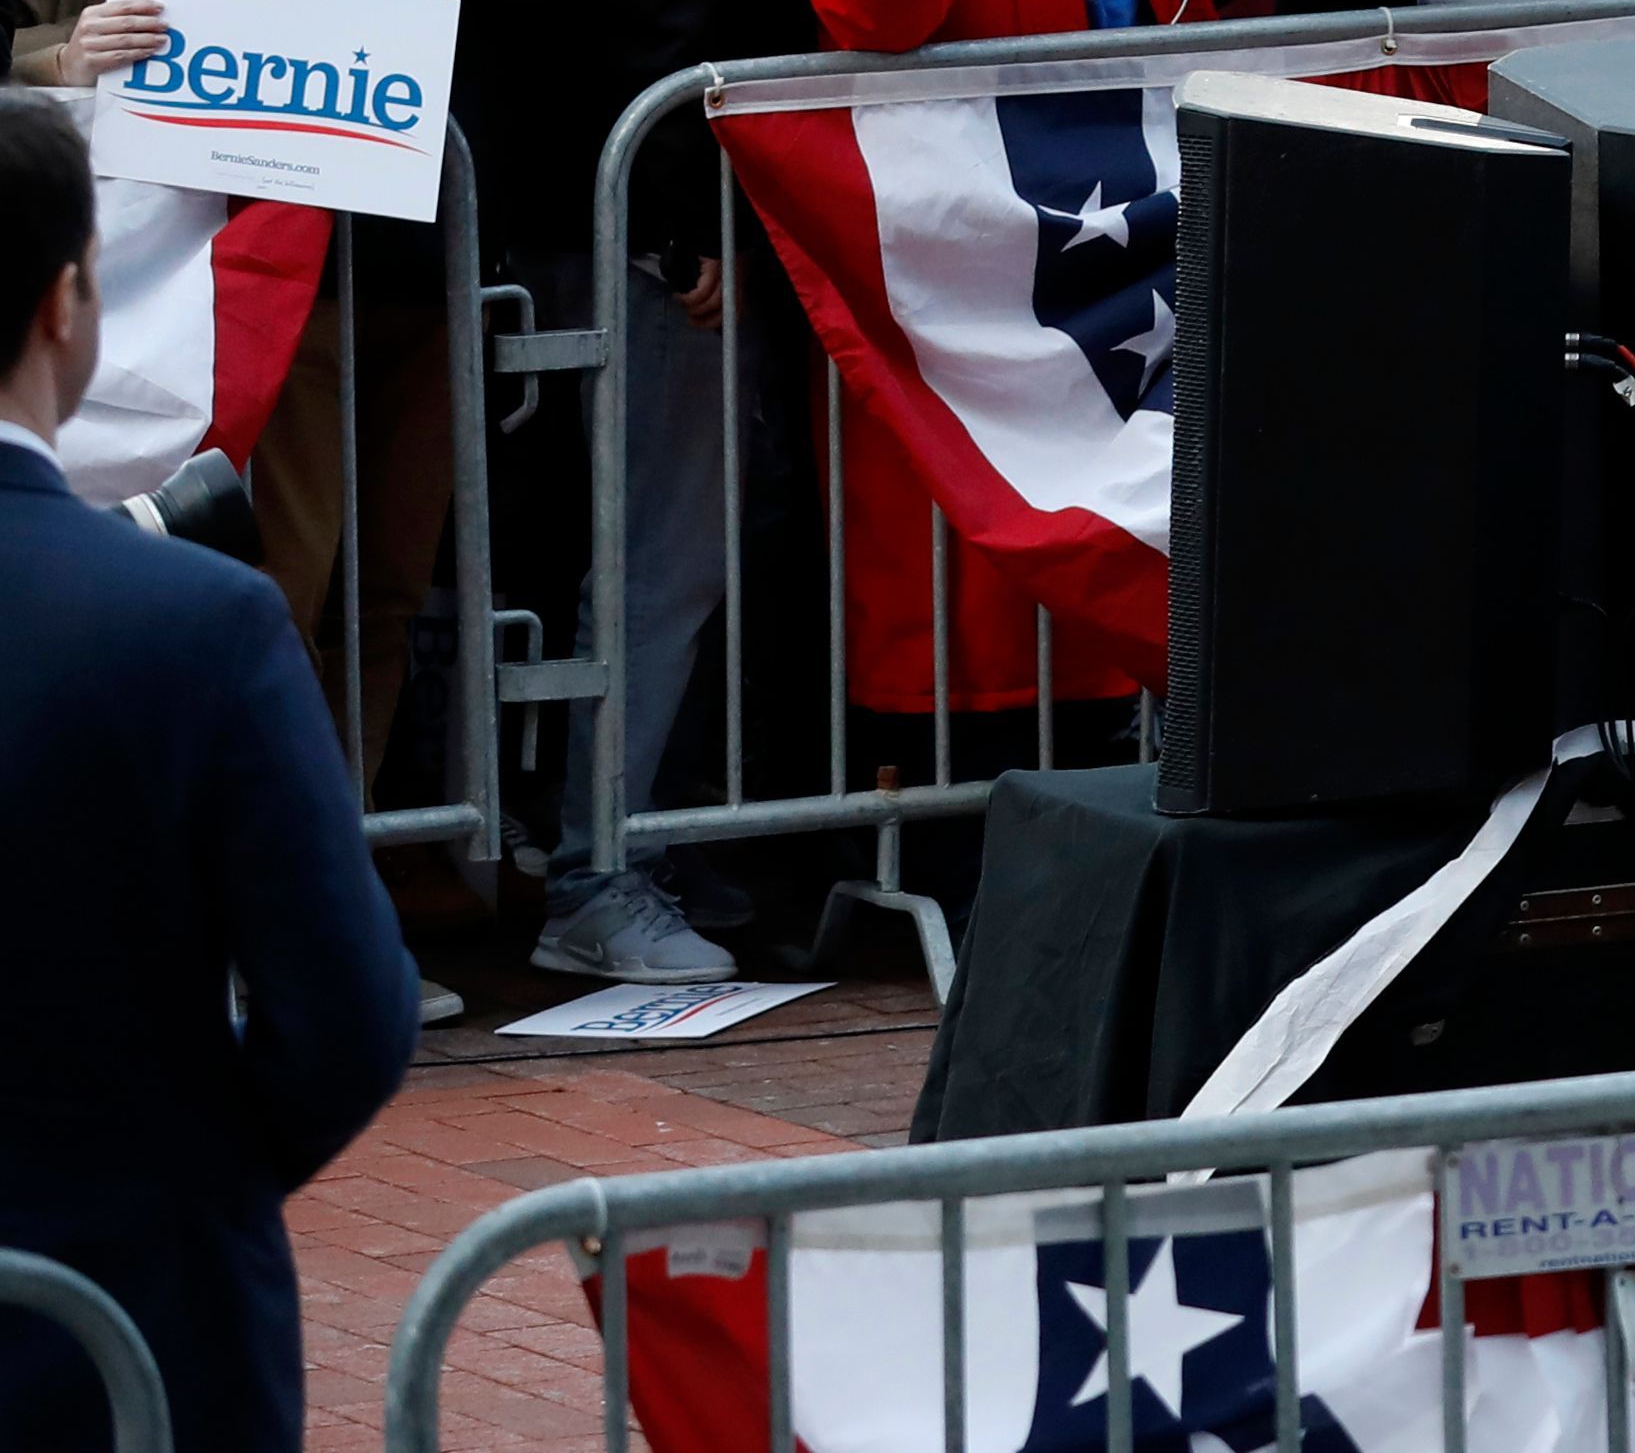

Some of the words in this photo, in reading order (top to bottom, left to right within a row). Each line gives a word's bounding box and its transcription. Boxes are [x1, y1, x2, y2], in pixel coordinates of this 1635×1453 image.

[124, 25, 424, 134] Bernie
[210, 149, 321, 176] BernieSanders.com
[571, 983, 742, 1033] Bernie
